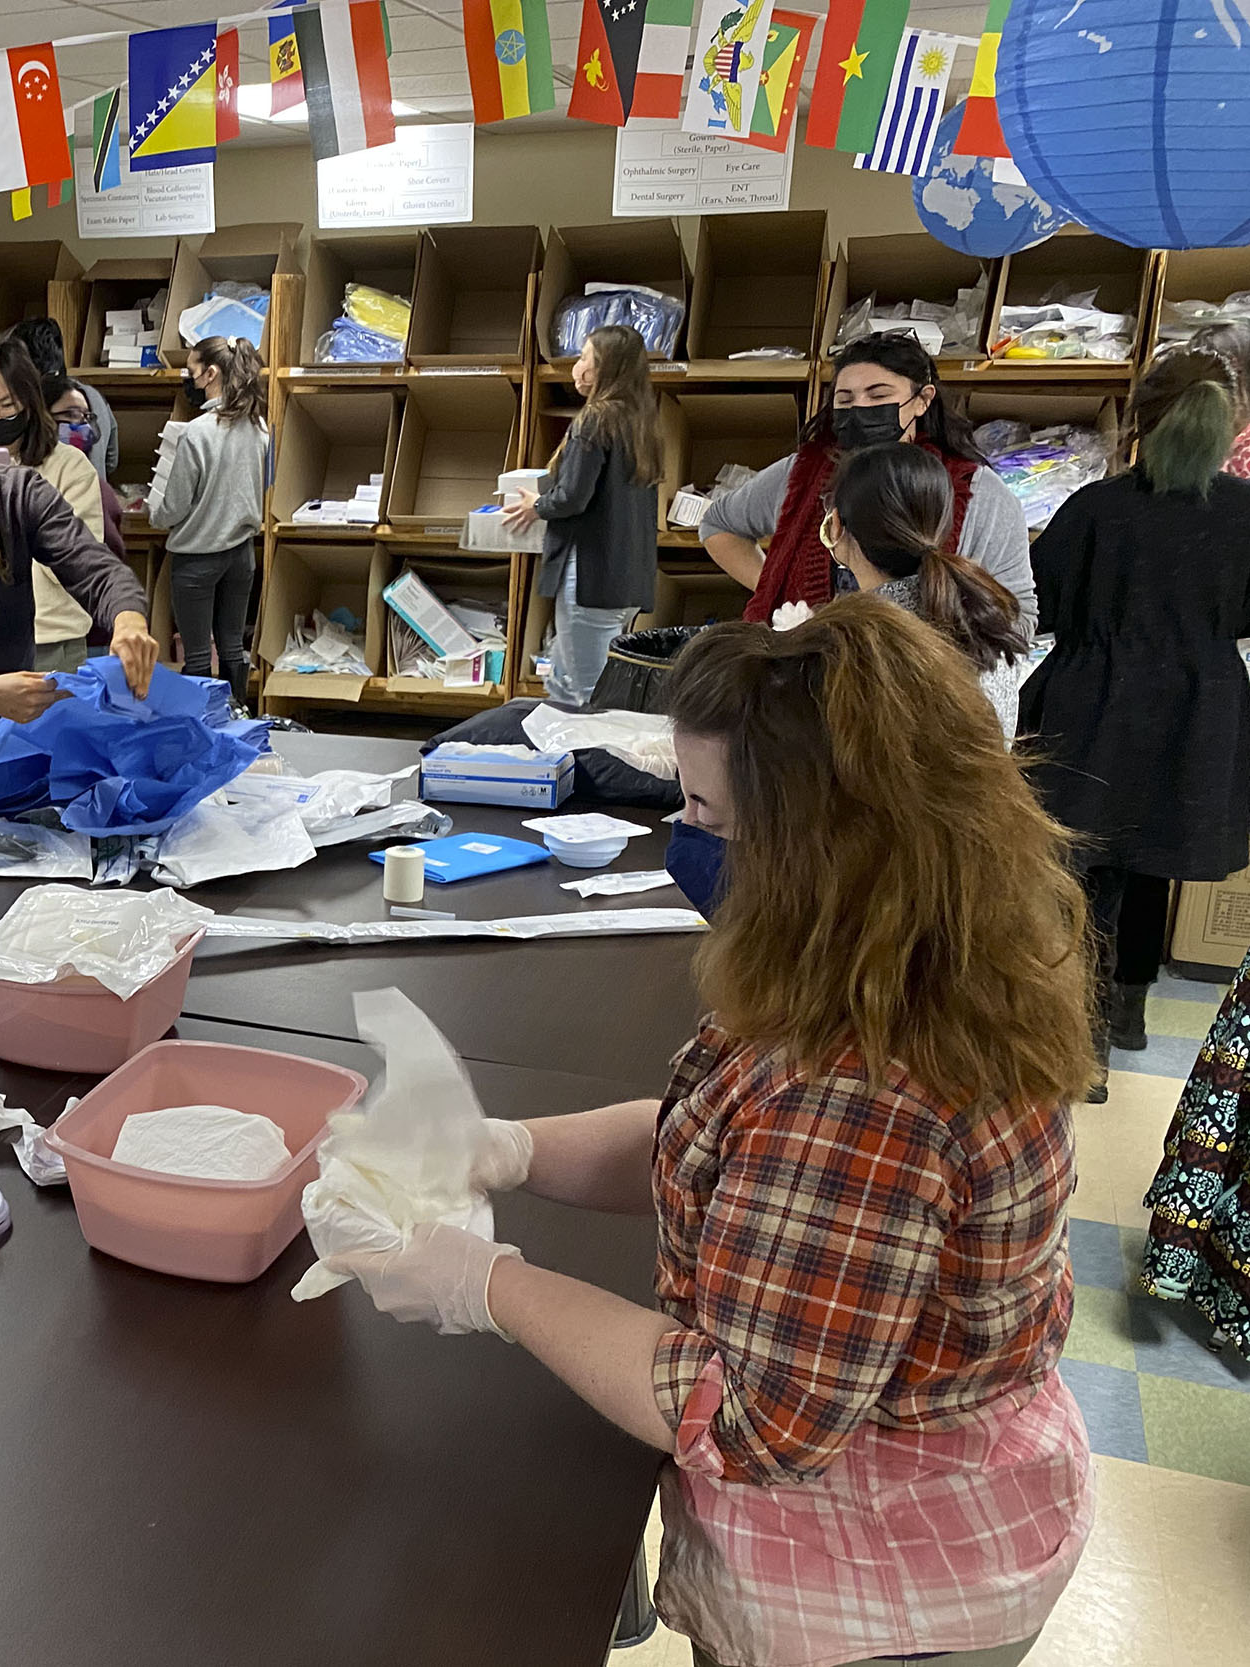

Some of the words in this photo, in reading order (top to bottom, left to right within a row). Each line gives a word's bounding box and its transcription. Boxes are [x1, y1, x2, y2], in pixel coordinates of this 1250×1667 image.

[674, 145, 701, 156] (Sterile,
[705, 144, 730, 155] Paper)
[179, 167, 201, 175] Covers
[623, 166, 666, 178] Ophthalmic
[668, 166, 696, 177] Surgery
[726, 163, 740, 173] Eye
[741, 162, 760, 171] Care
[426, 176, 450, 185] Covers
[146, 186, 165, 194] Blood
[731, 183, 750, 193] ENT
[108, 193, 140, 201] Containers
[179, 193, 204, 202] Supplies
[630, 193, 654, 201] Dental
[656, 193, 685, 202] Surgery
[701, 195, 724, 205] (Ears,
[725, 195, 747, 204] Nose,
[749, 193, 779, 203] Throat)
[403, 201, 426, 209] Gloves
[427, 200, 455, 209] (Sterile)
[118, 216, 135, 225] Paper
[155, 213, 167, 222] Lab
[168, 213, 194, 222] Supplies
